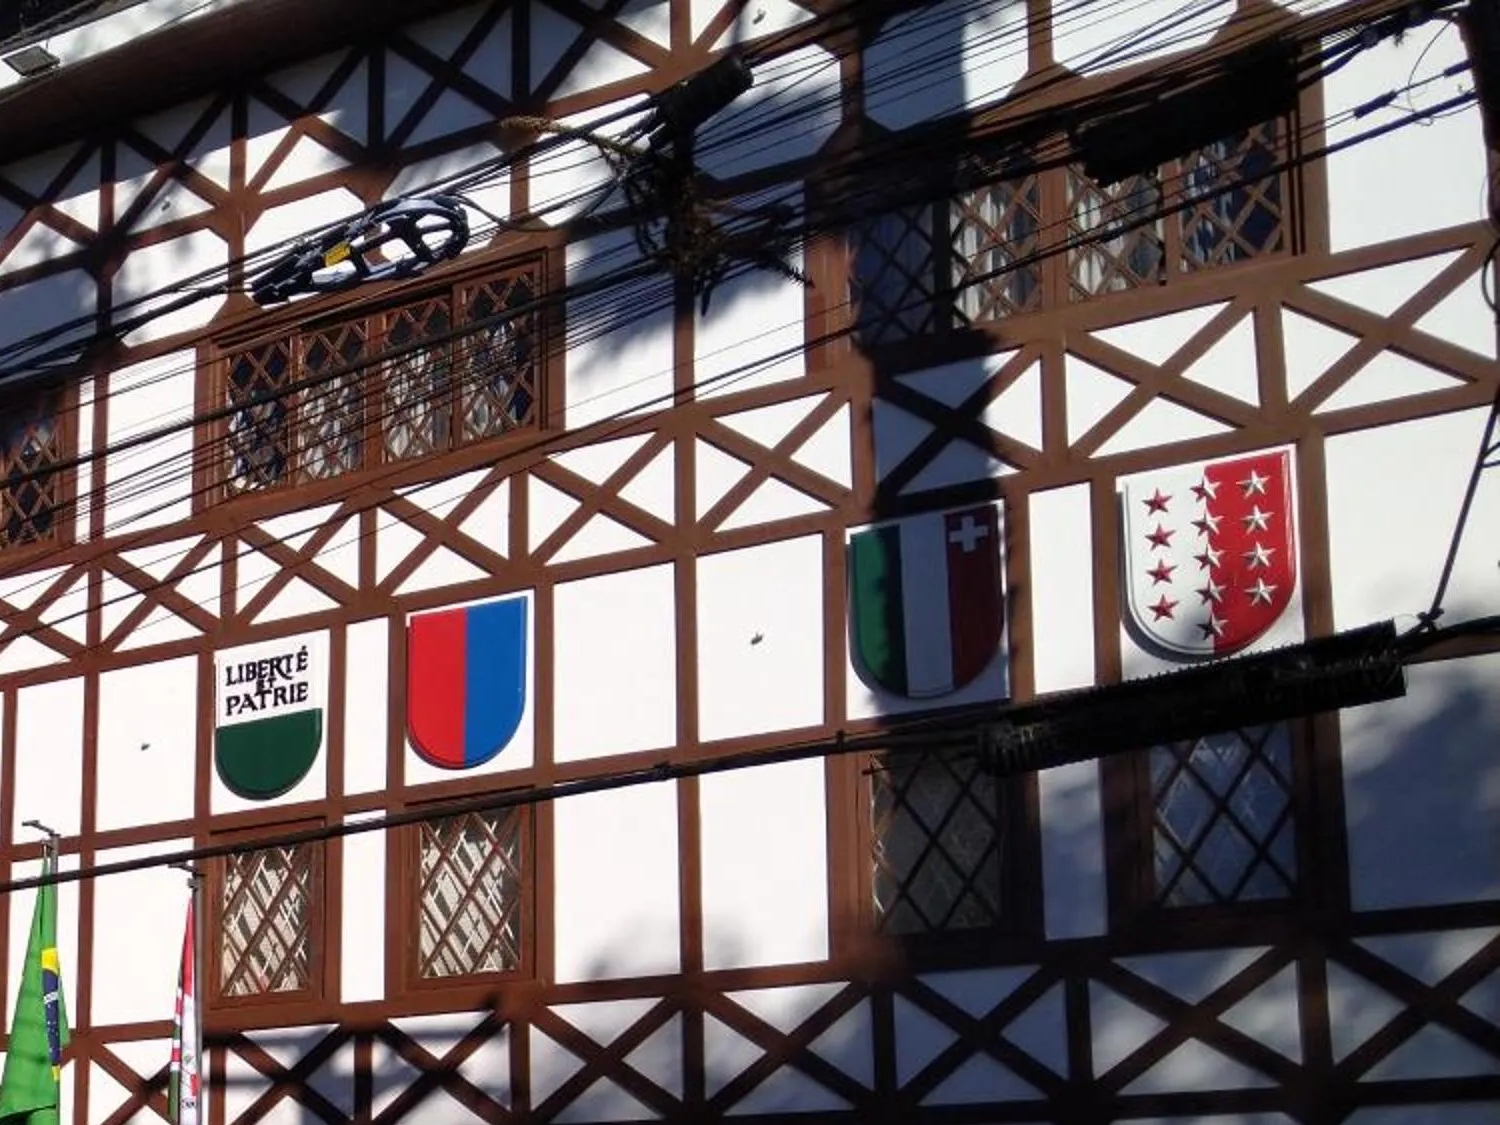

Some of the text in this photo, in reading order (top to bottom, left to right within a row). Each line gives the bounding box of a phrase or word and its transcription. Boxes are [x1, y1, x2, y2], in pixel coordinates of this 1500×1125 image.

[226, 645, 309, 686] LIBERTÉ
[226, 681, 308, 716] PATRIE
[256, 677, 276, 692] ET
